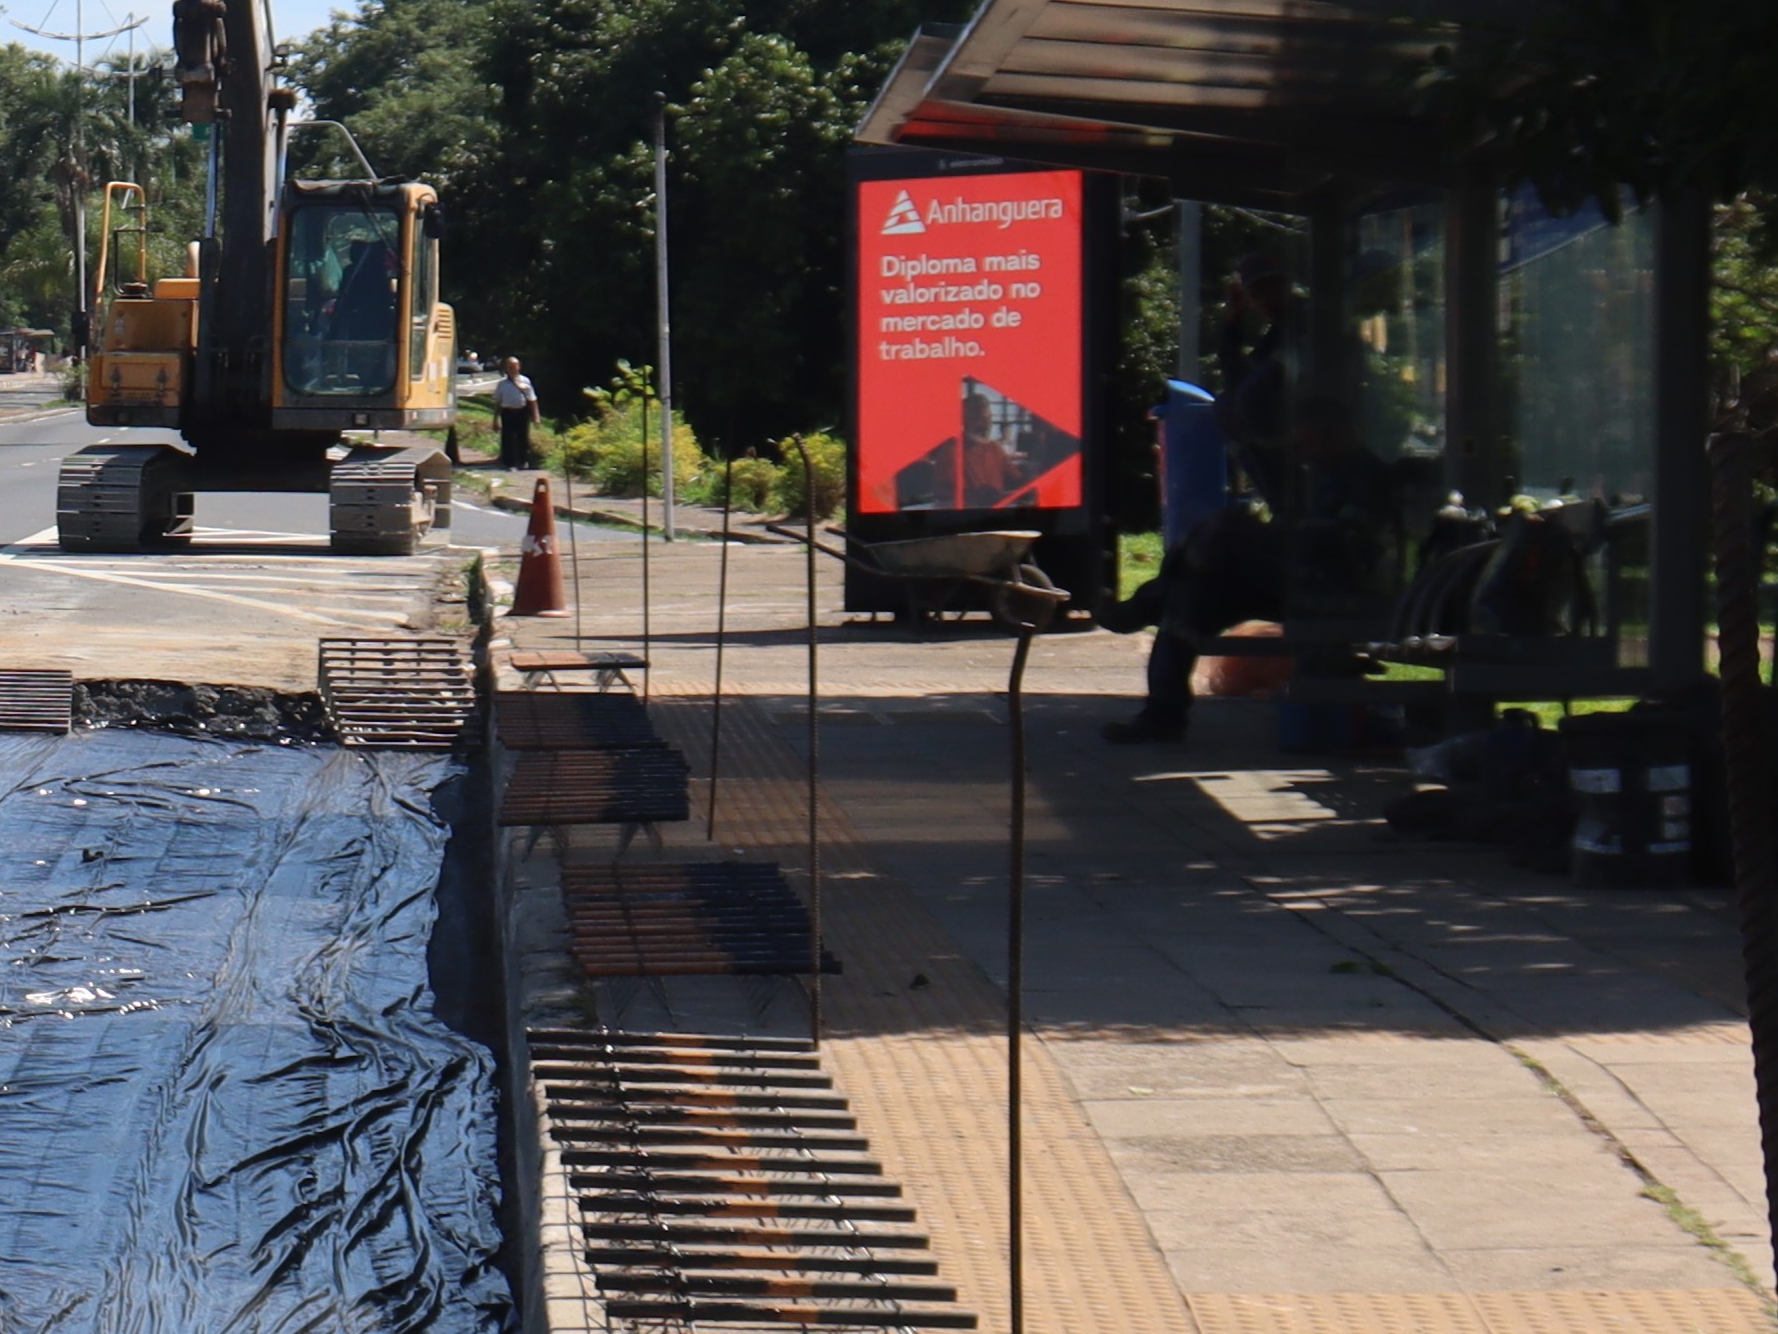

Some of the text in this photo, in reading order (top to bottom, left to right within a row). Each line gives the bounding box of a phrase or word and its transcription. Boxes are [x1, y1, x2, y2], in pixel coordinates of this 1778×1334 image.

[926, 196, 1063, 229] Anhanguera
[881, 249, 1041, 281] Diploma mais
[881, 279, 1041, 305] valorizado no
[881, 306, 1022, 332] mercado de
[880, 336, 986, 360] trabalho.
